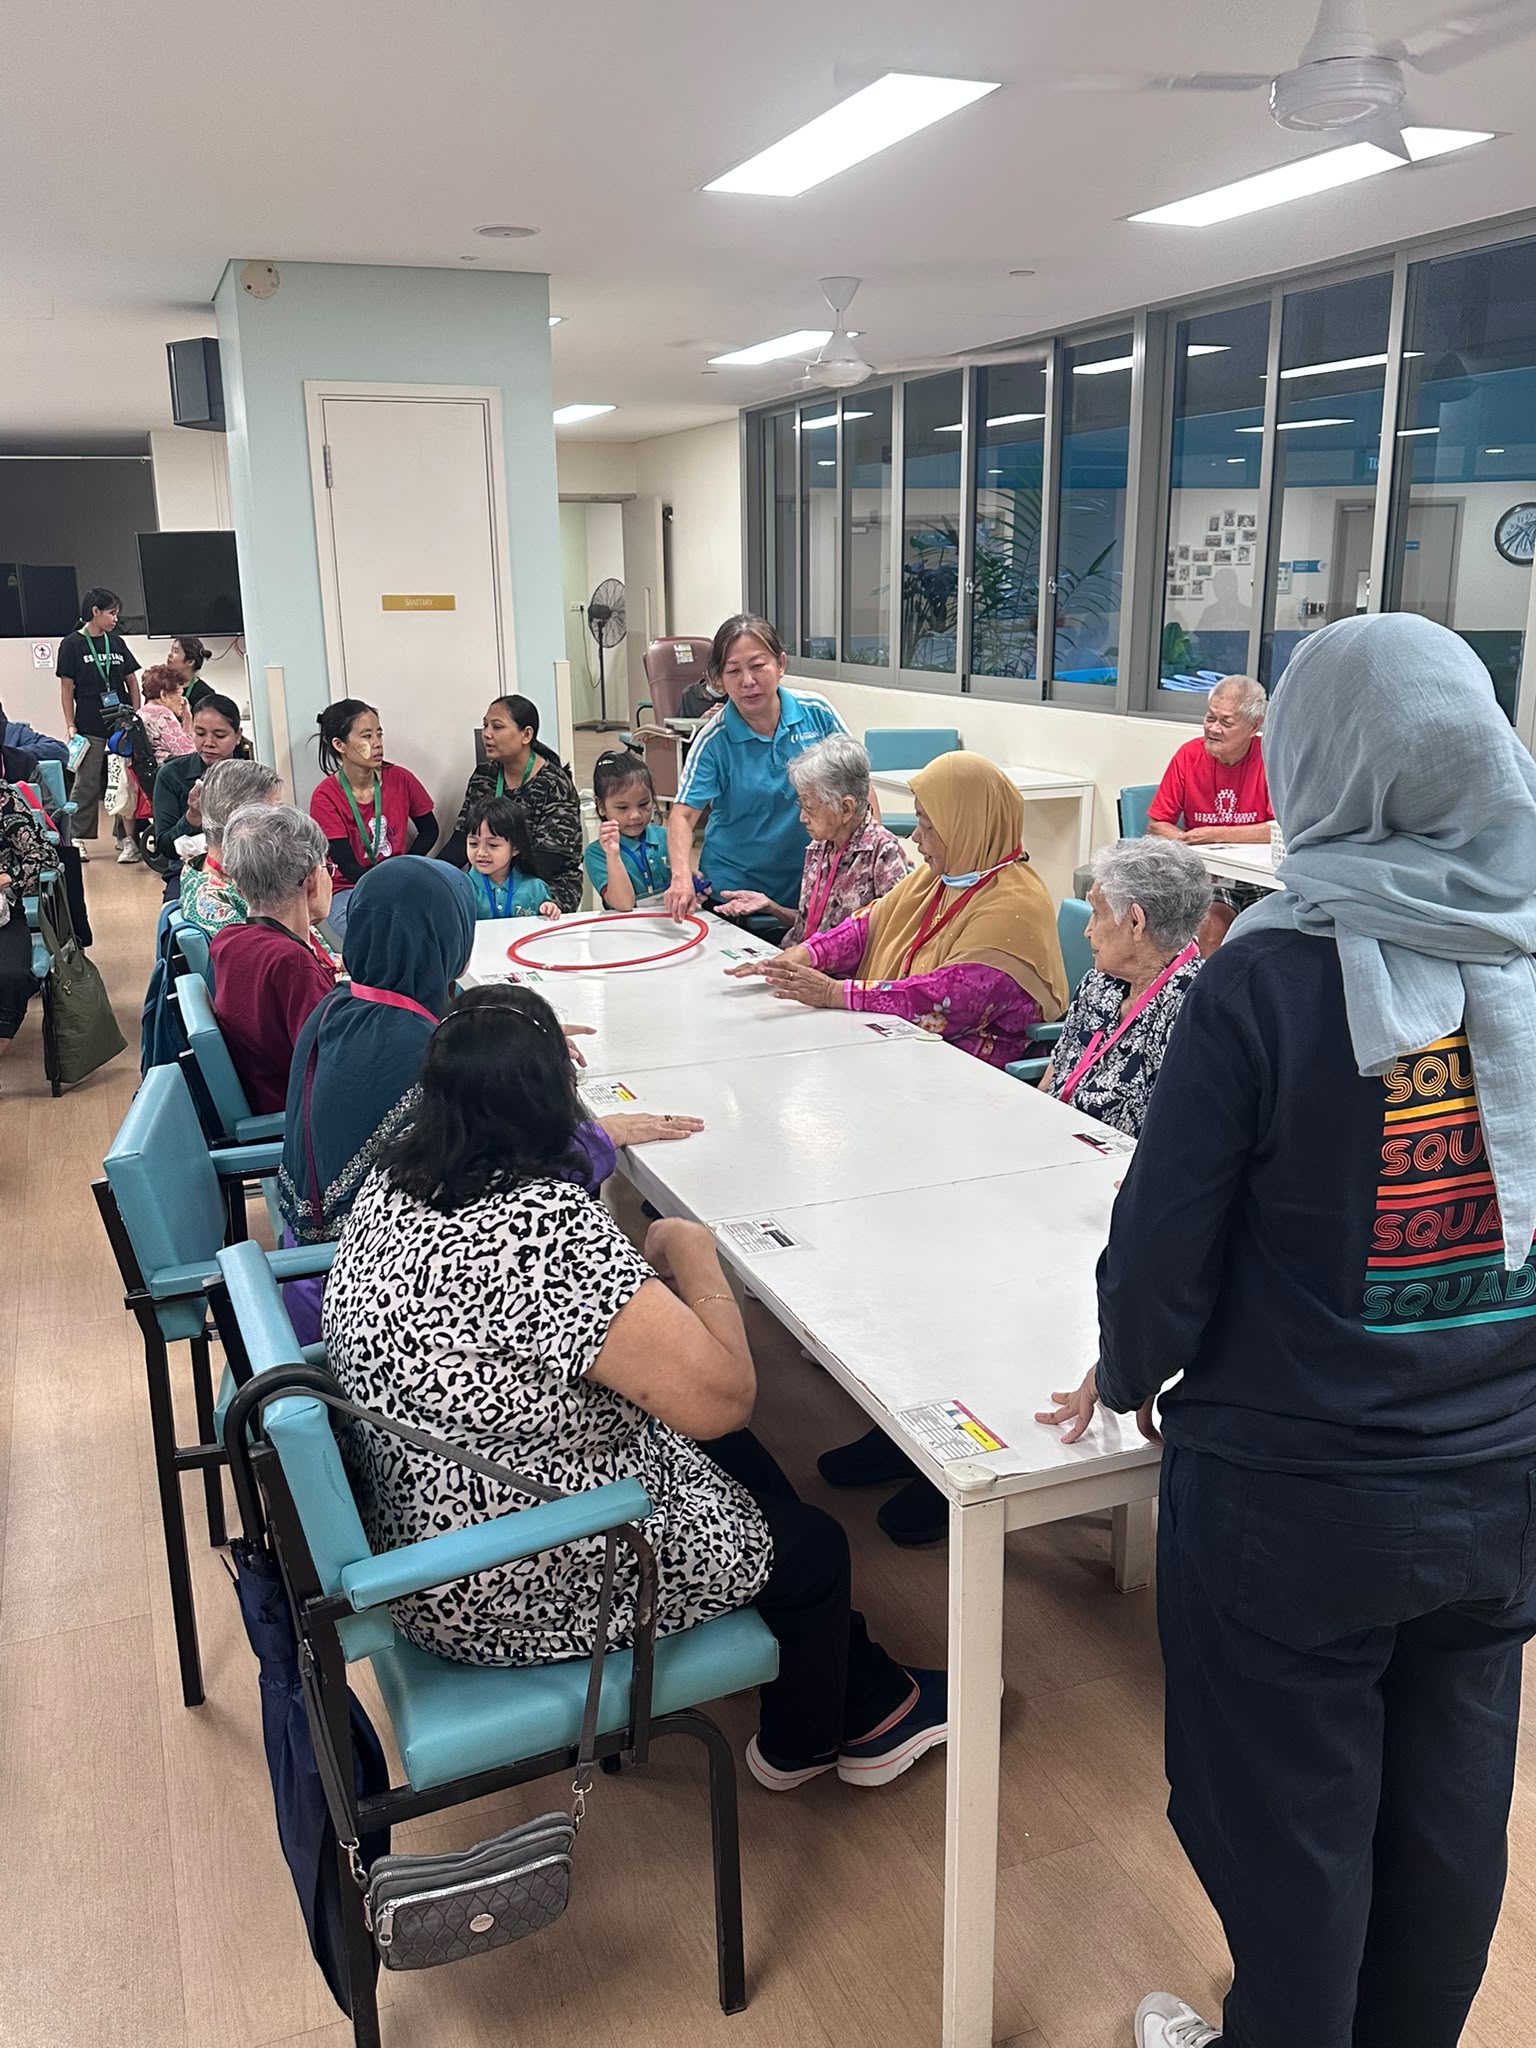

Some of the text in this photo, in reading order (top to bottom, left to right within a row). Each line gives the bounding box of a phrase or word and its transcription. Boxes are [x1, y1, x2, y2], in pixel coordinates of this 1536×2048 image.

[404, 598, 433, 607] SANITARY
[1383, 1053, 1474, 1104] SQU
[1380, 1128, 1488, 1176] SQU
[1371, 1201, 1502, 1249] SQUA
[1361, 1264, 1536, 1319] SQUAD
